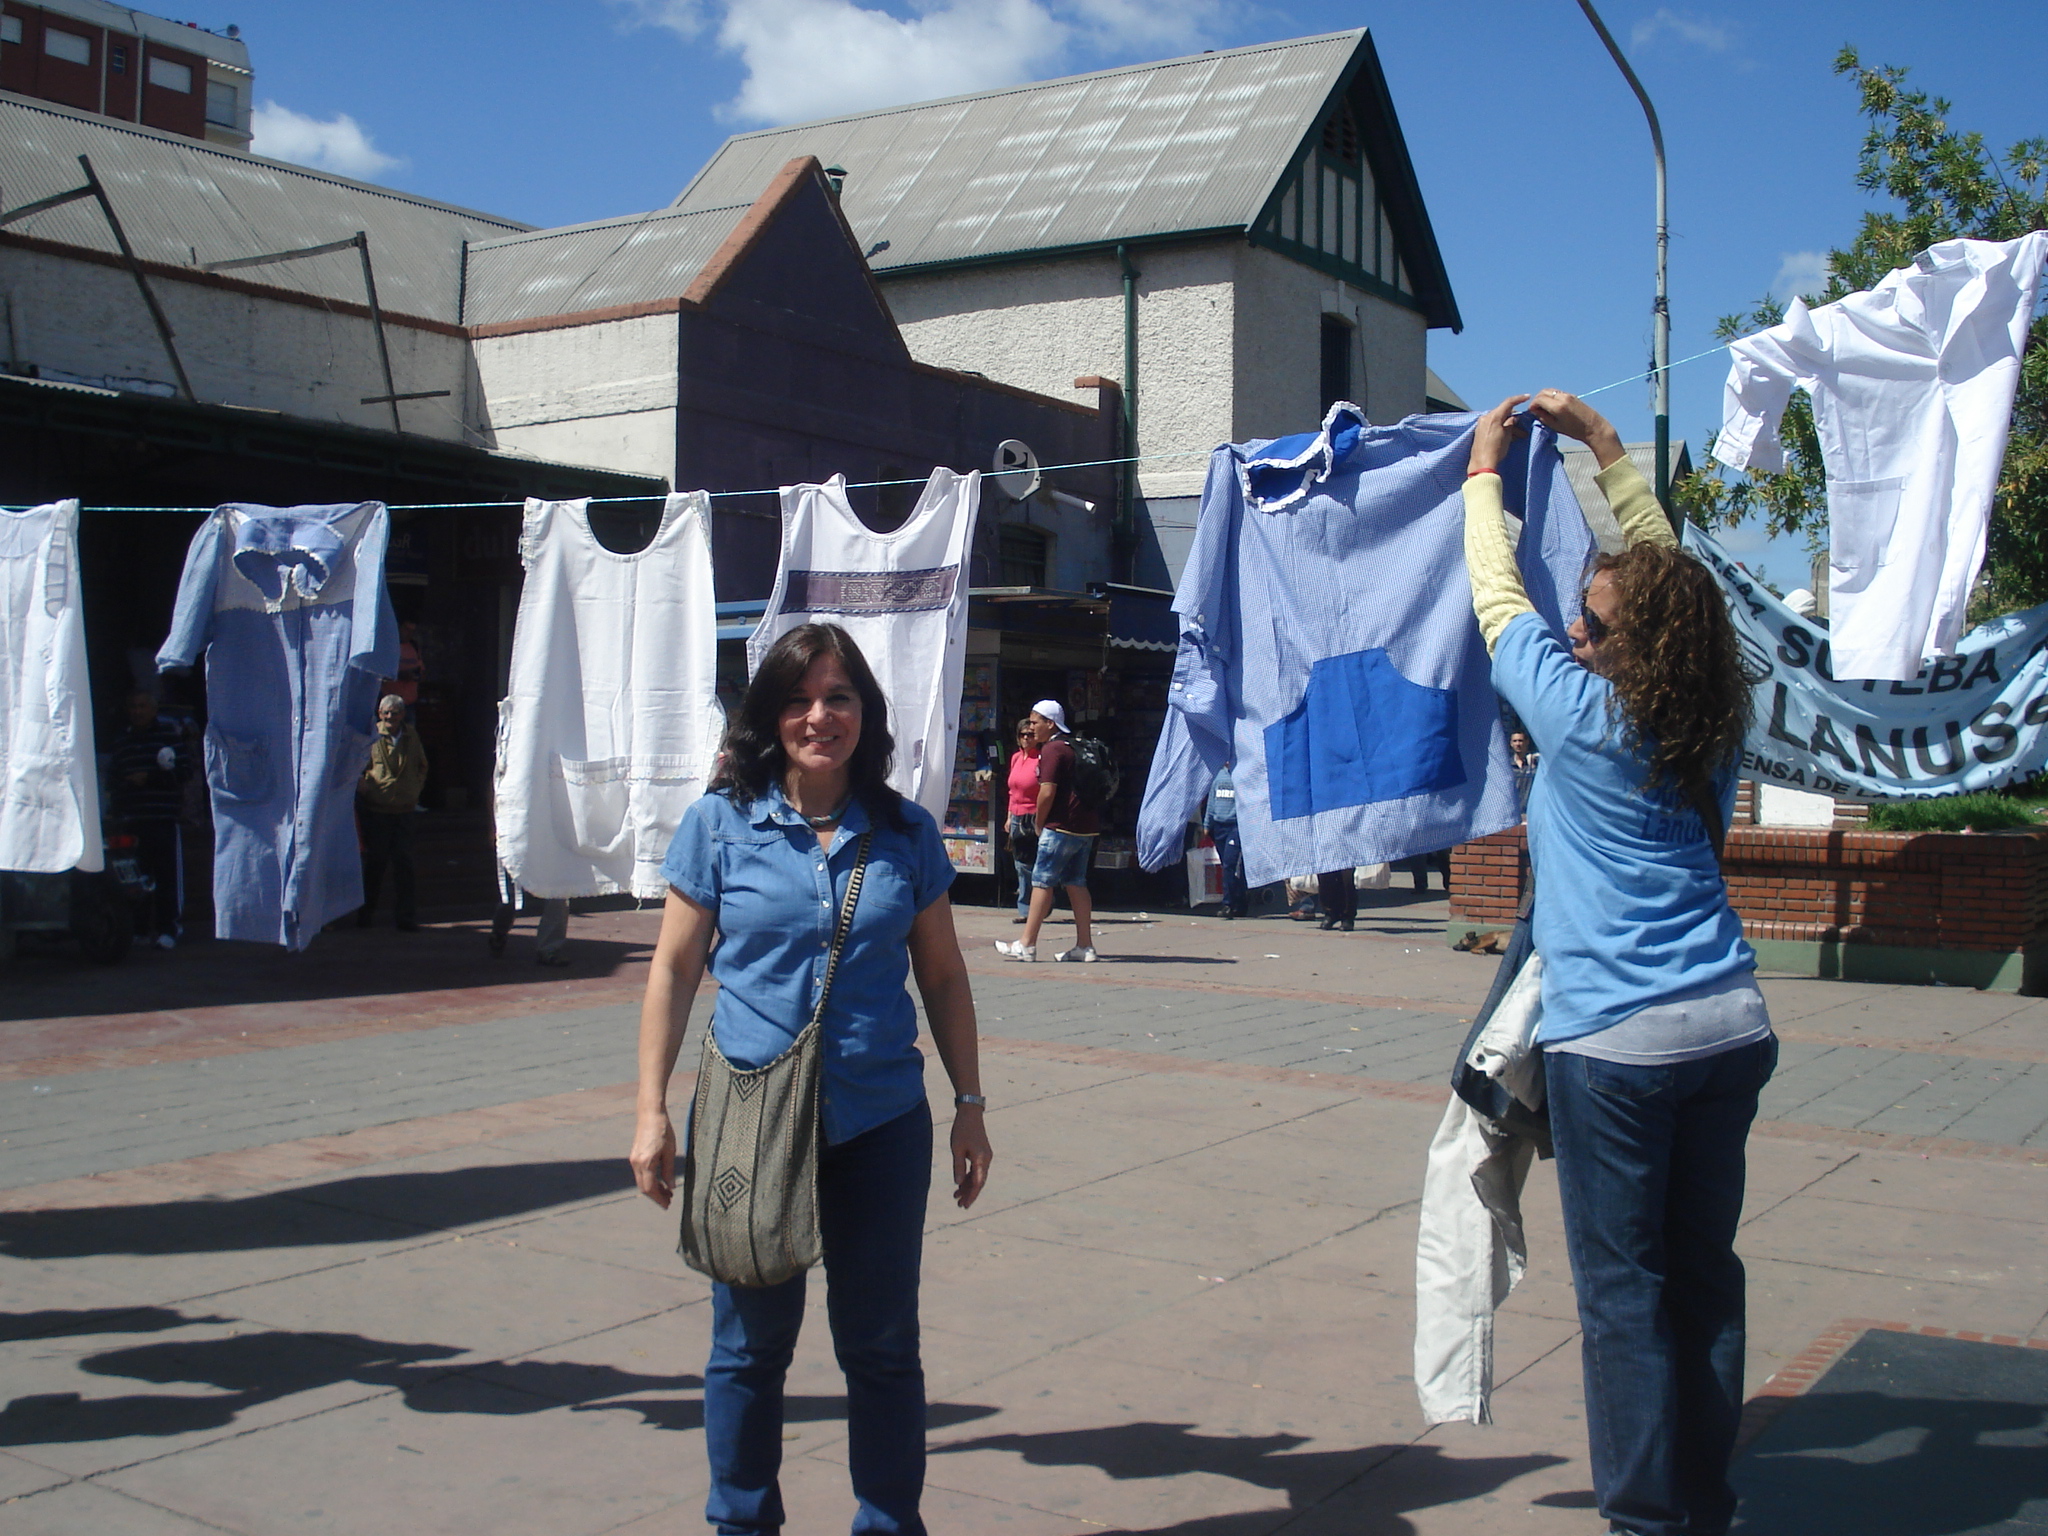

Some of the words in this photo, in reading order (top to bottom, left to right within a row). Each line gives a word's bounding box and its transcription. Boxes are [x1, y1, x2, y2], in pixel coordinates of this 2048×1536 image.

[1777, 625, 2001, 695] SUEBA
[1769, 681, 2018, 779] LANUS
[1813, 775, 1851, 795] DE
